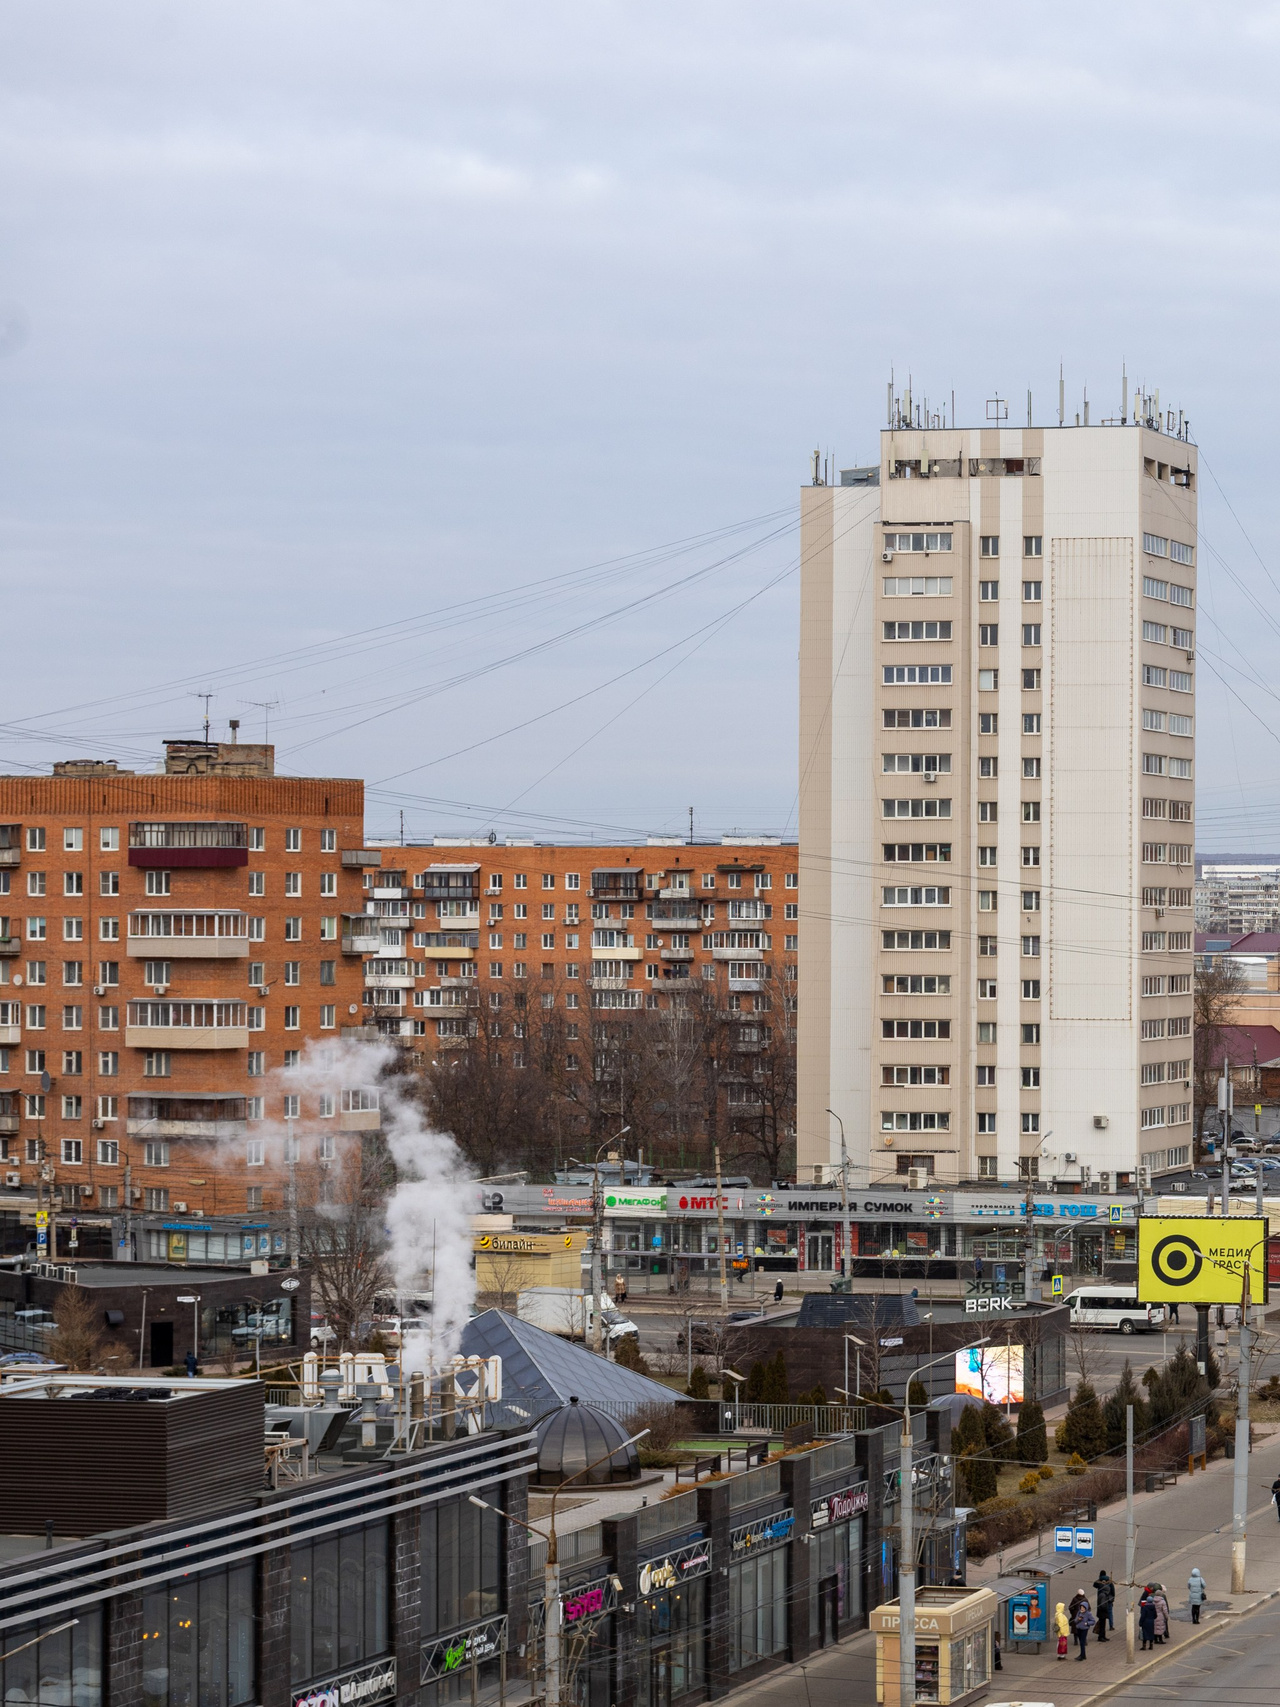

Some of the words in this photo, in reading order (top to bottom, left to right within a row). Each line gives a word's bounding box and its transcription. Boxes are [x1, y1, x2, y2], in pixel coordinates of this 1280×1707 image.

[482, 1189, 503, 1210] t2
[864, 1202, 913, 1213] СУМОК
[1060, 1204, 1098, 1217] ГОШ
[491, 1237, 534, 1250] билайн
[1209, 1248, 1251, 1258] МЕДИА
[965, 1296, 1013, 1313] BORK
[965, 1605, 984, 1622] ПРЕССА
